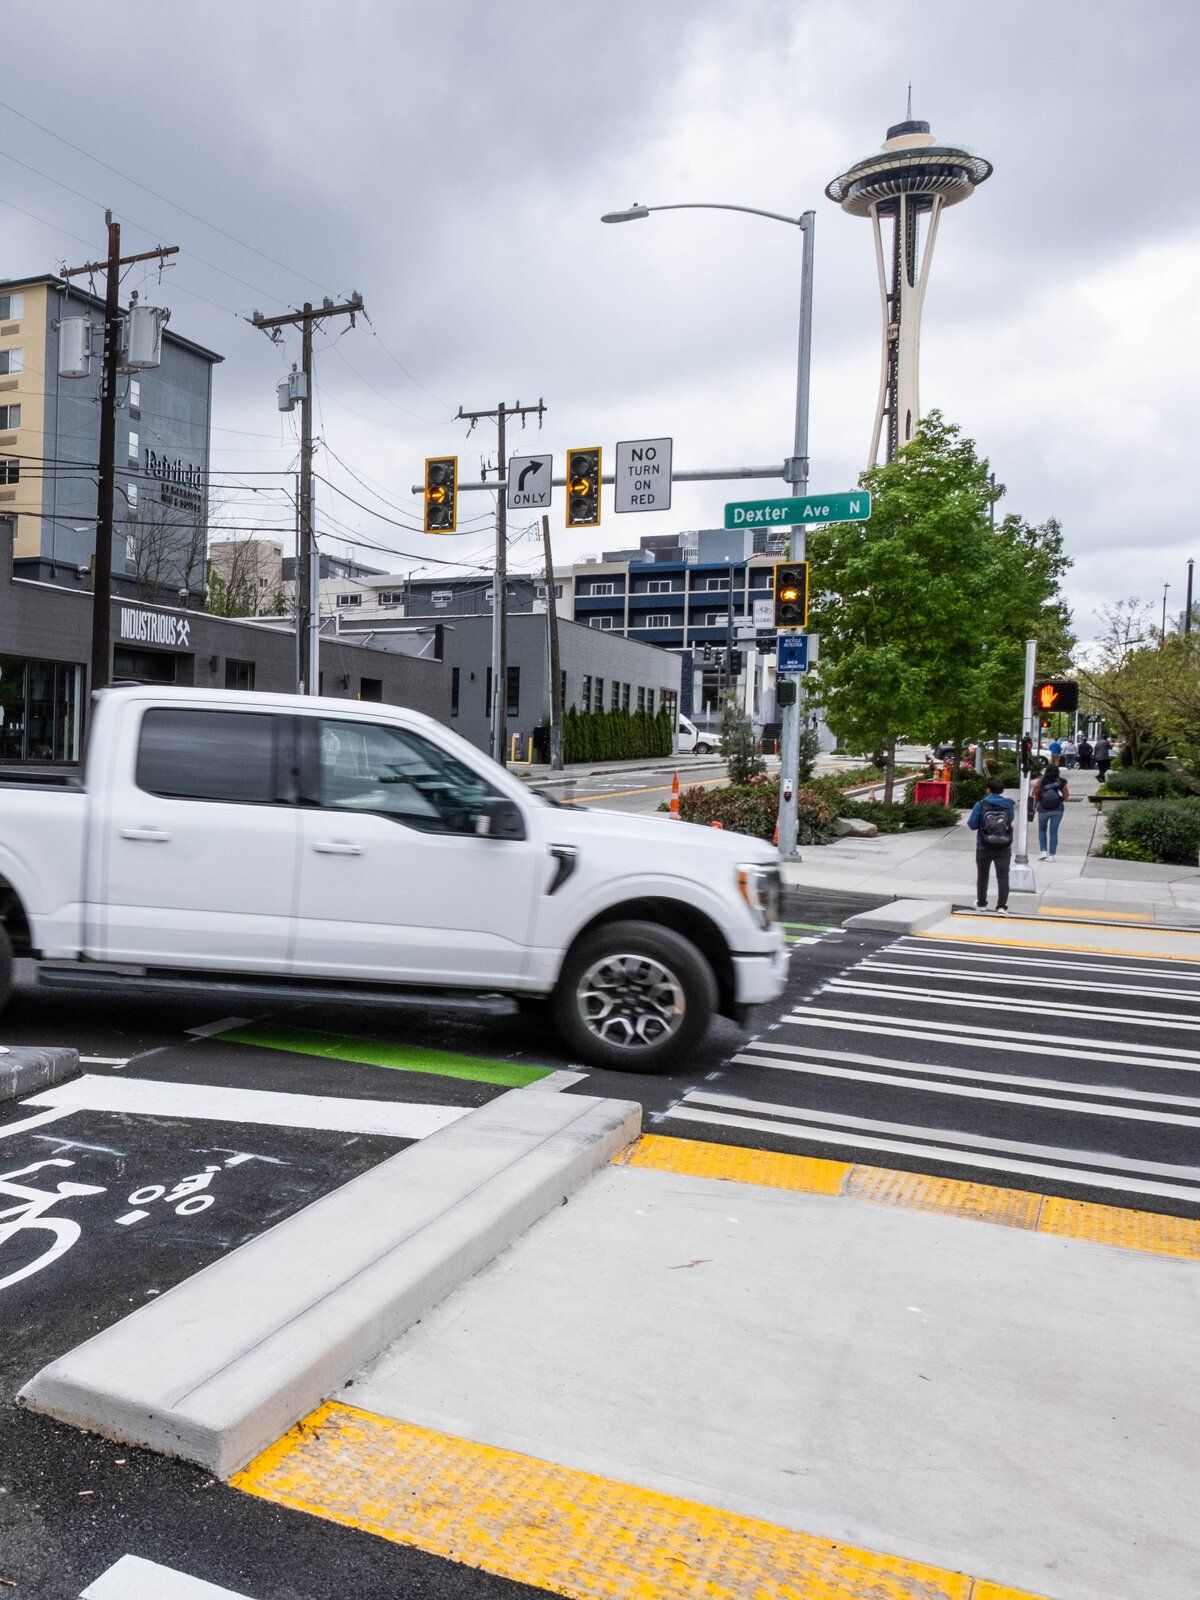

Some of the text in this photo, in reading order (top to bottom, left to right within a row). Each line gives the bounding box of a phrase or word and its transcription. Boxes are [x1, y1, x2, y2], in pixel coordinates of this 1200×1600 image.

[631, 447, 657, 462] NO
[145, 448, 202, 491] Fairfield
[628, 464, 660, 476] TURN
[634, 480, 651, 491] ON
[513, 492, 546, 505] ONLY
[631, 494, 655, 505] RED
[733, 500, 860, 523] Dexter Ave N
[121, 607, 177, 645] INDUSTRIOUS
